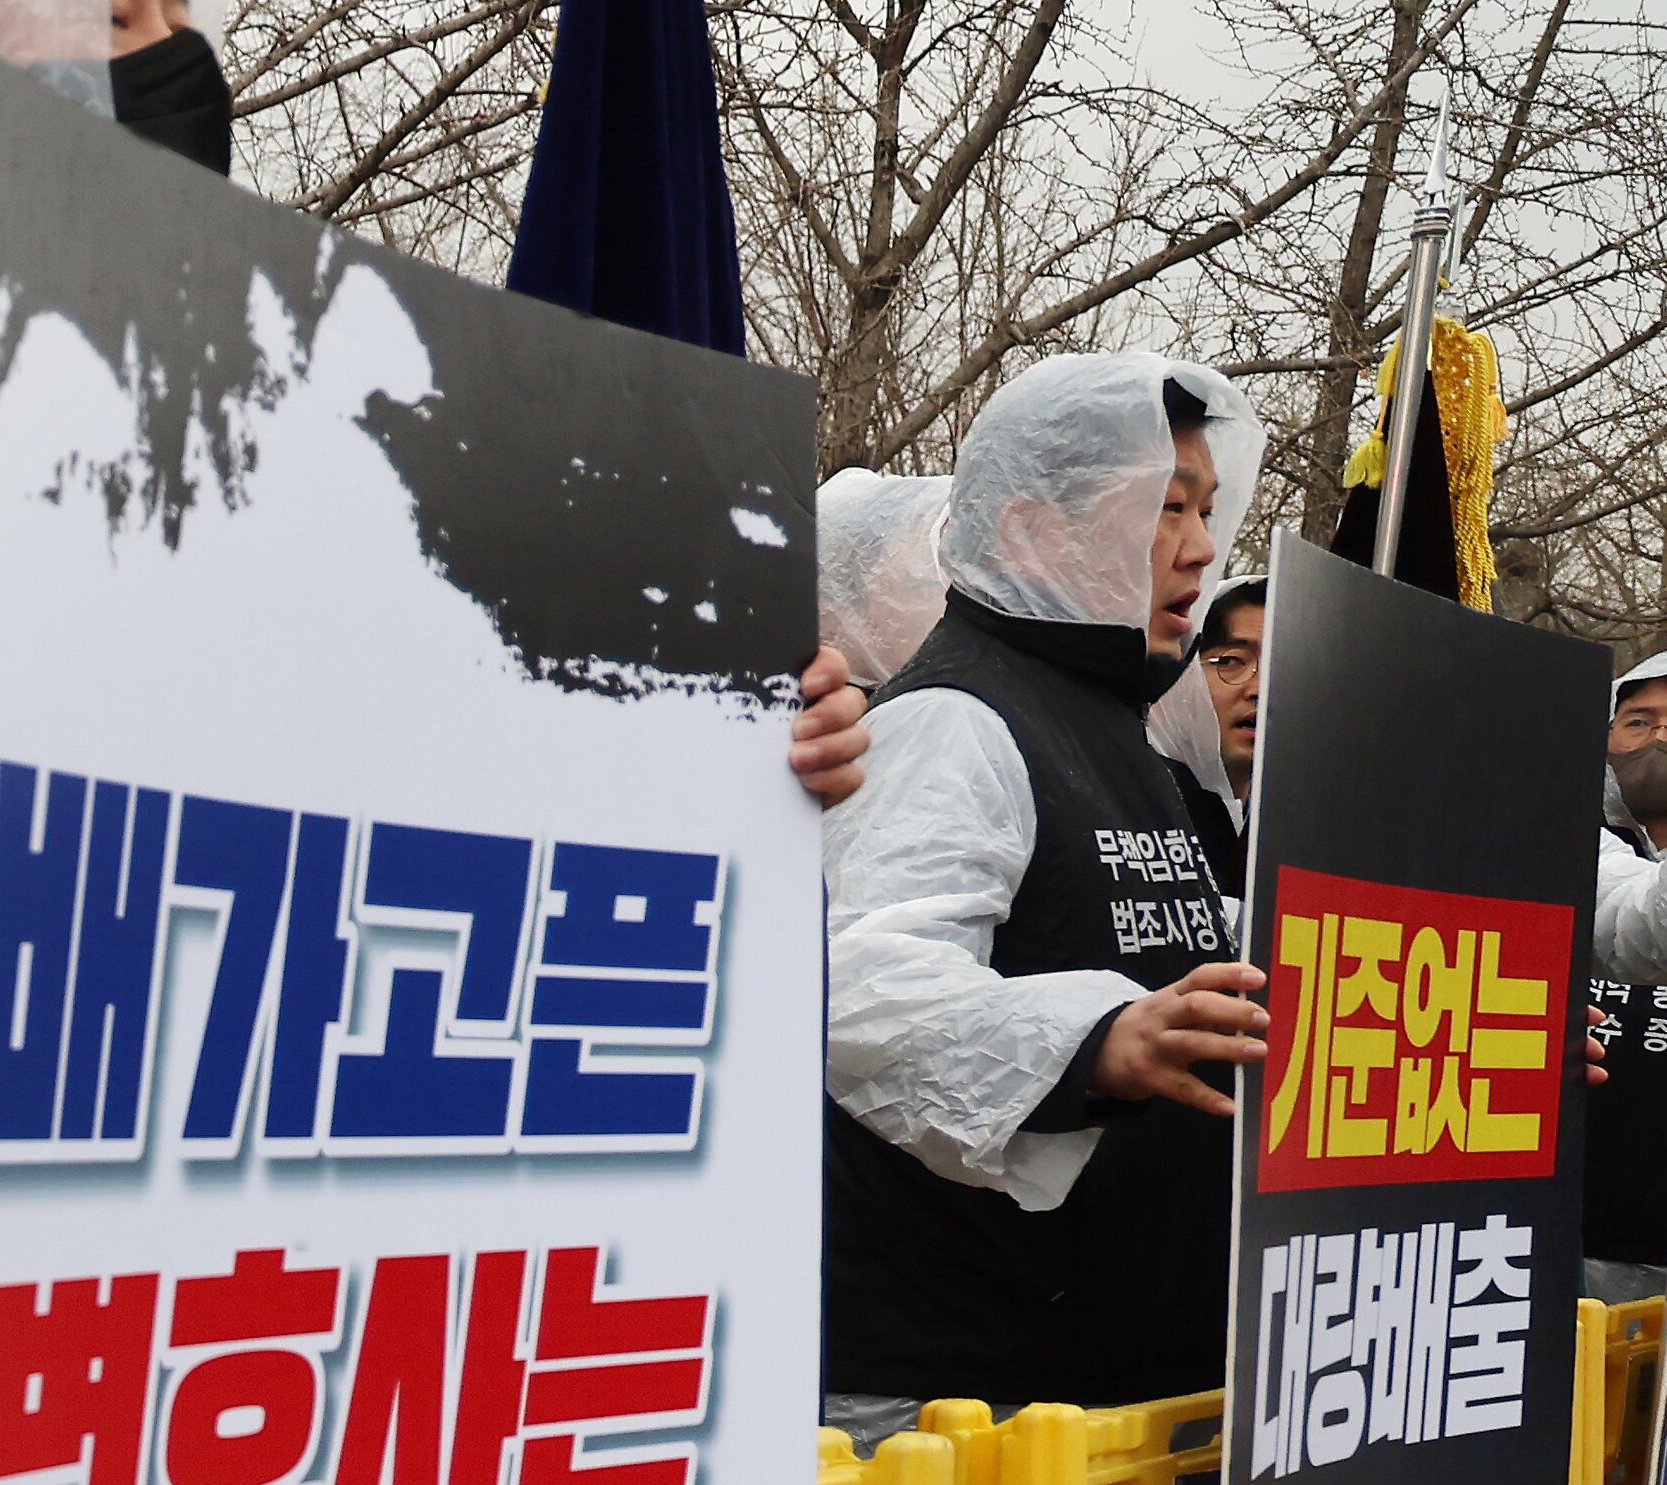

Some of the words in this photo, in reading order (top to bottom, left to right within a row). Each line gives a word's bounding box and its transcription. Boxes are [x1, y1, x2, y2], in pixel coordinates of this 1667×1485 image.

[1095, 829, 1198, 882] 무책임한
[1110, 898, 1218, 954] 법조시장
[1268, 912, 1548, 1159] 기준없는
[1251, 1214, 1533, 1479] 대량배출
